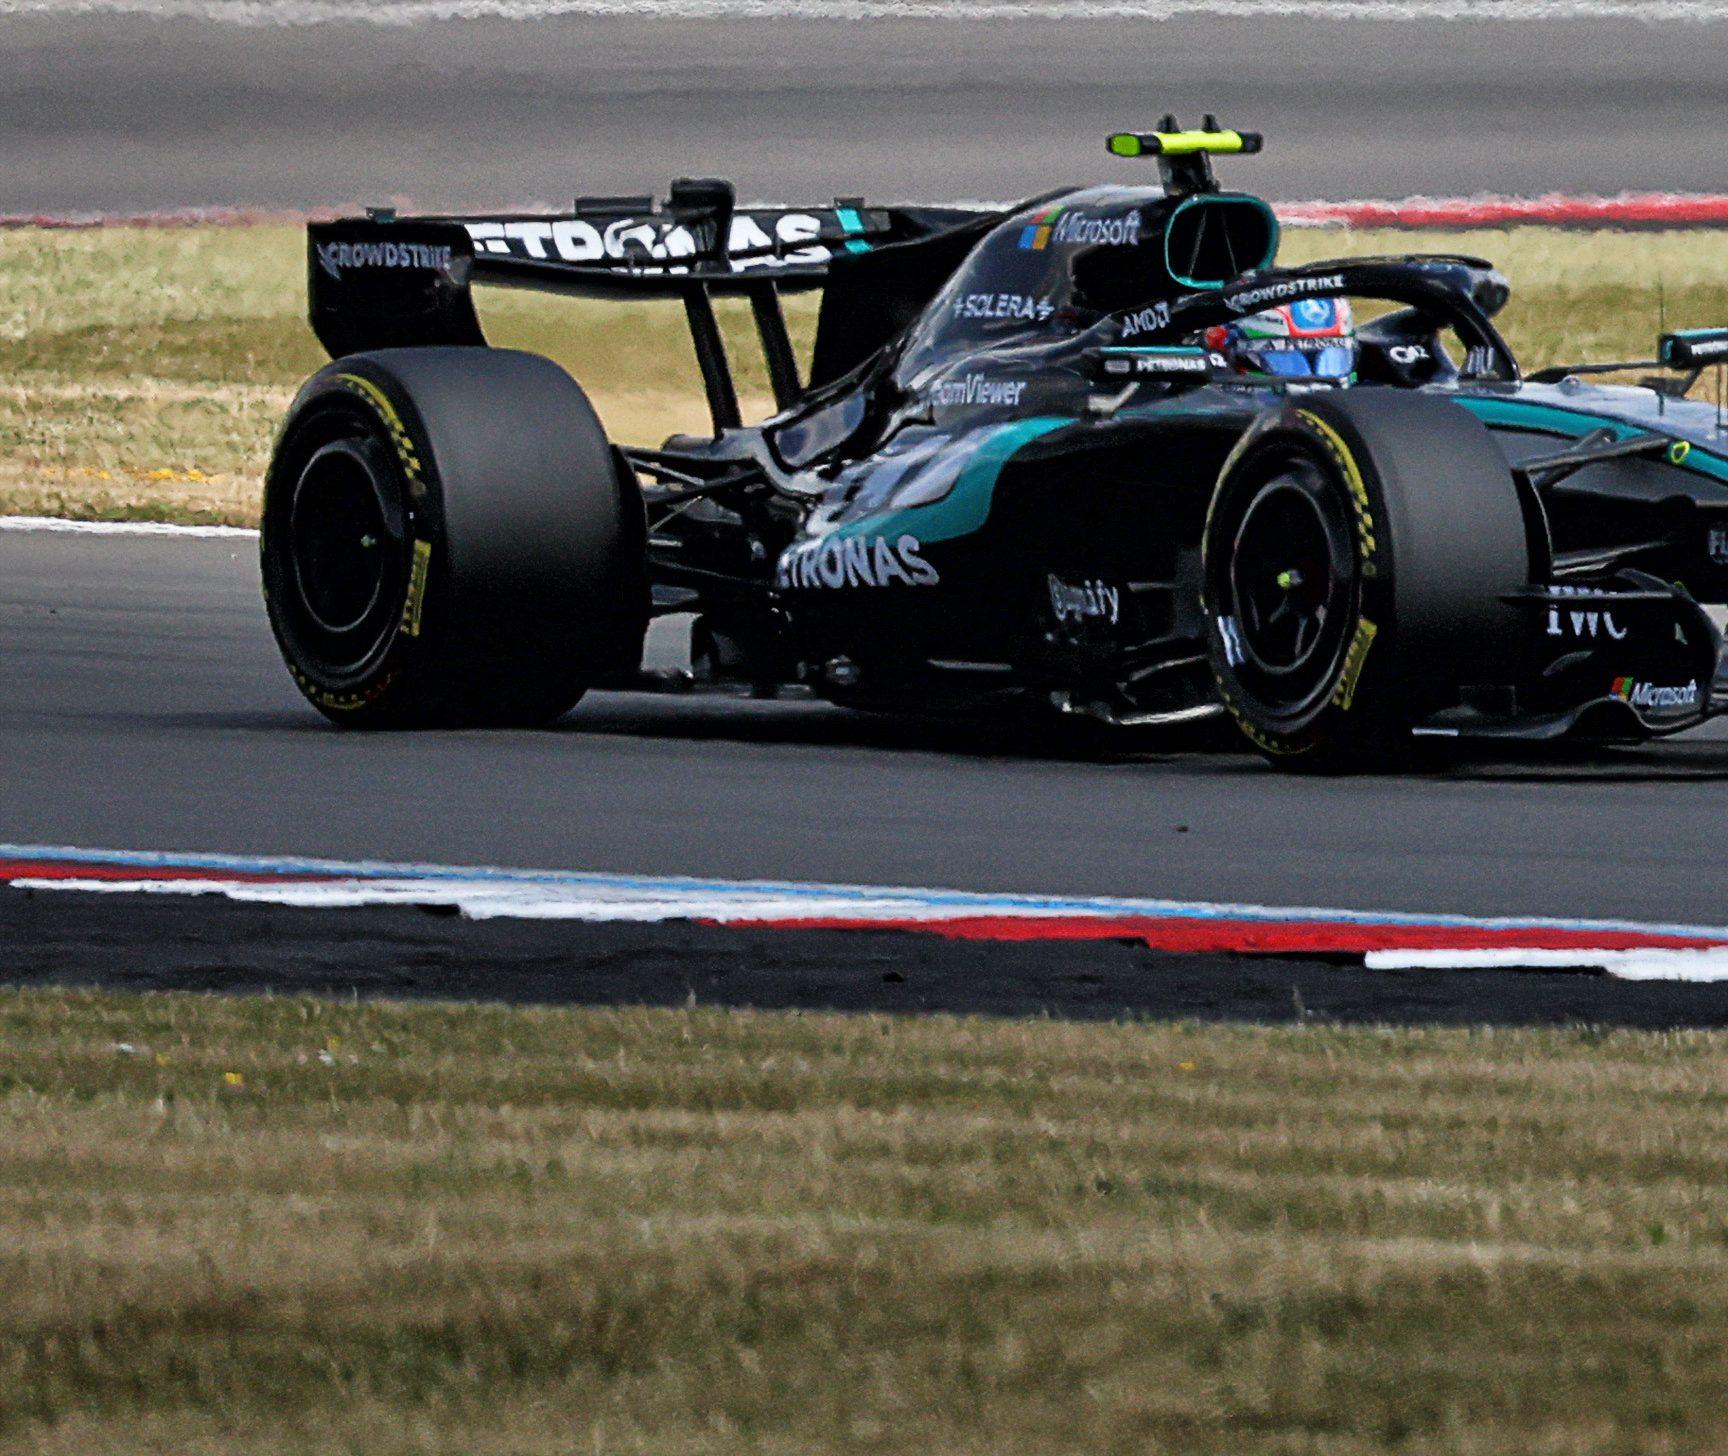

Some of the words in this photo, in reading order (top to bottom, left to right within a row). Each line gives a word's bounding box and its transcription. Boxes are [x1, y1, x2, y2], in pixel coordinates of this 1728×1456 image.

[1053, 209, 1141, 246] Microsoft
[1226, 274, 1345, 310] CROWDSTRIKE
[930, 373, 1028, 405] eamViewer
[776, 534, 939, 589] ETRONAS
